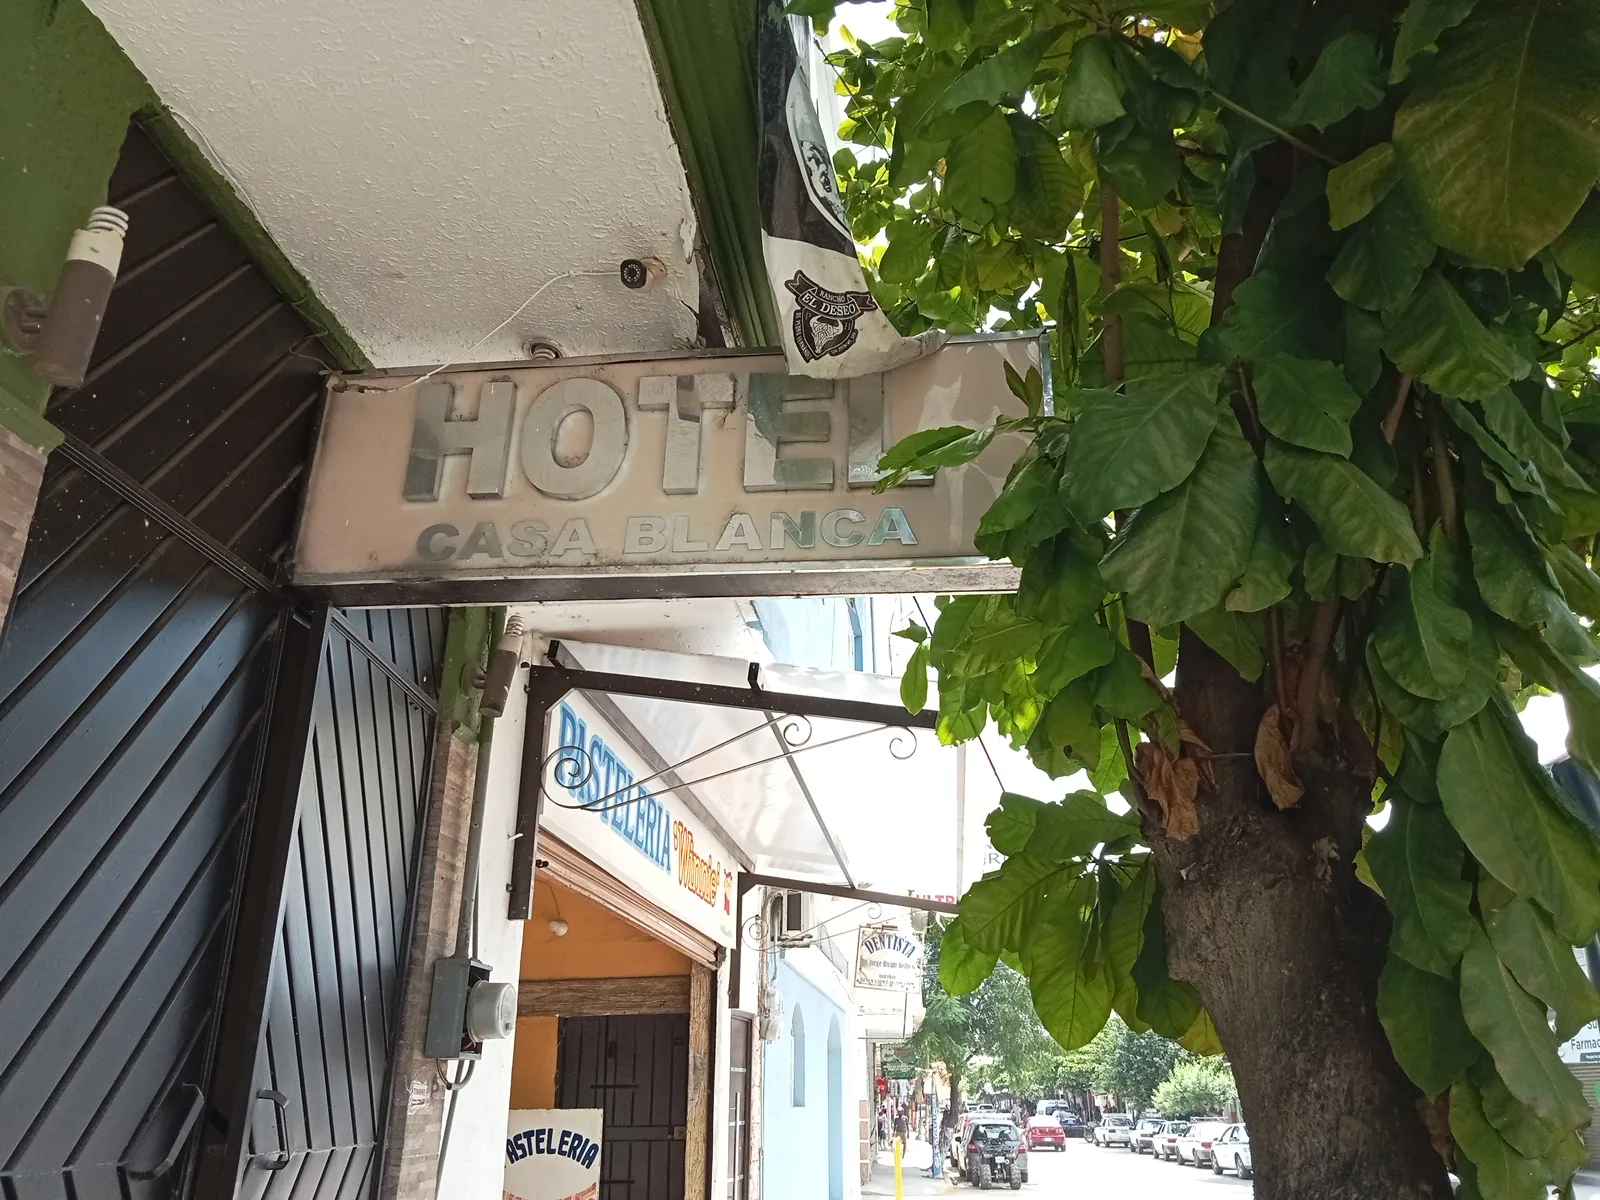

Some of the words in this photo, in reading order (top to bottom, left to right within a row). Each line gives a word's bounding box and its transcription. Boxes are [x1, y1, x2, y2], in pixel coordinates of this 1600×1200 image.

[802, 292, 817, 308] EL
[820, 302, 856, 316] DESEO
[820, 290, 846, 303] RANCHO
[402, 371, 935, 502] HOTEL
[416, 516, 598, 562] CASA
[623, 506, 918, 555] BLANCA
[553, 699, 672, 875] PASTELERIA
[864, 933, 917, 958] DENTISTA
